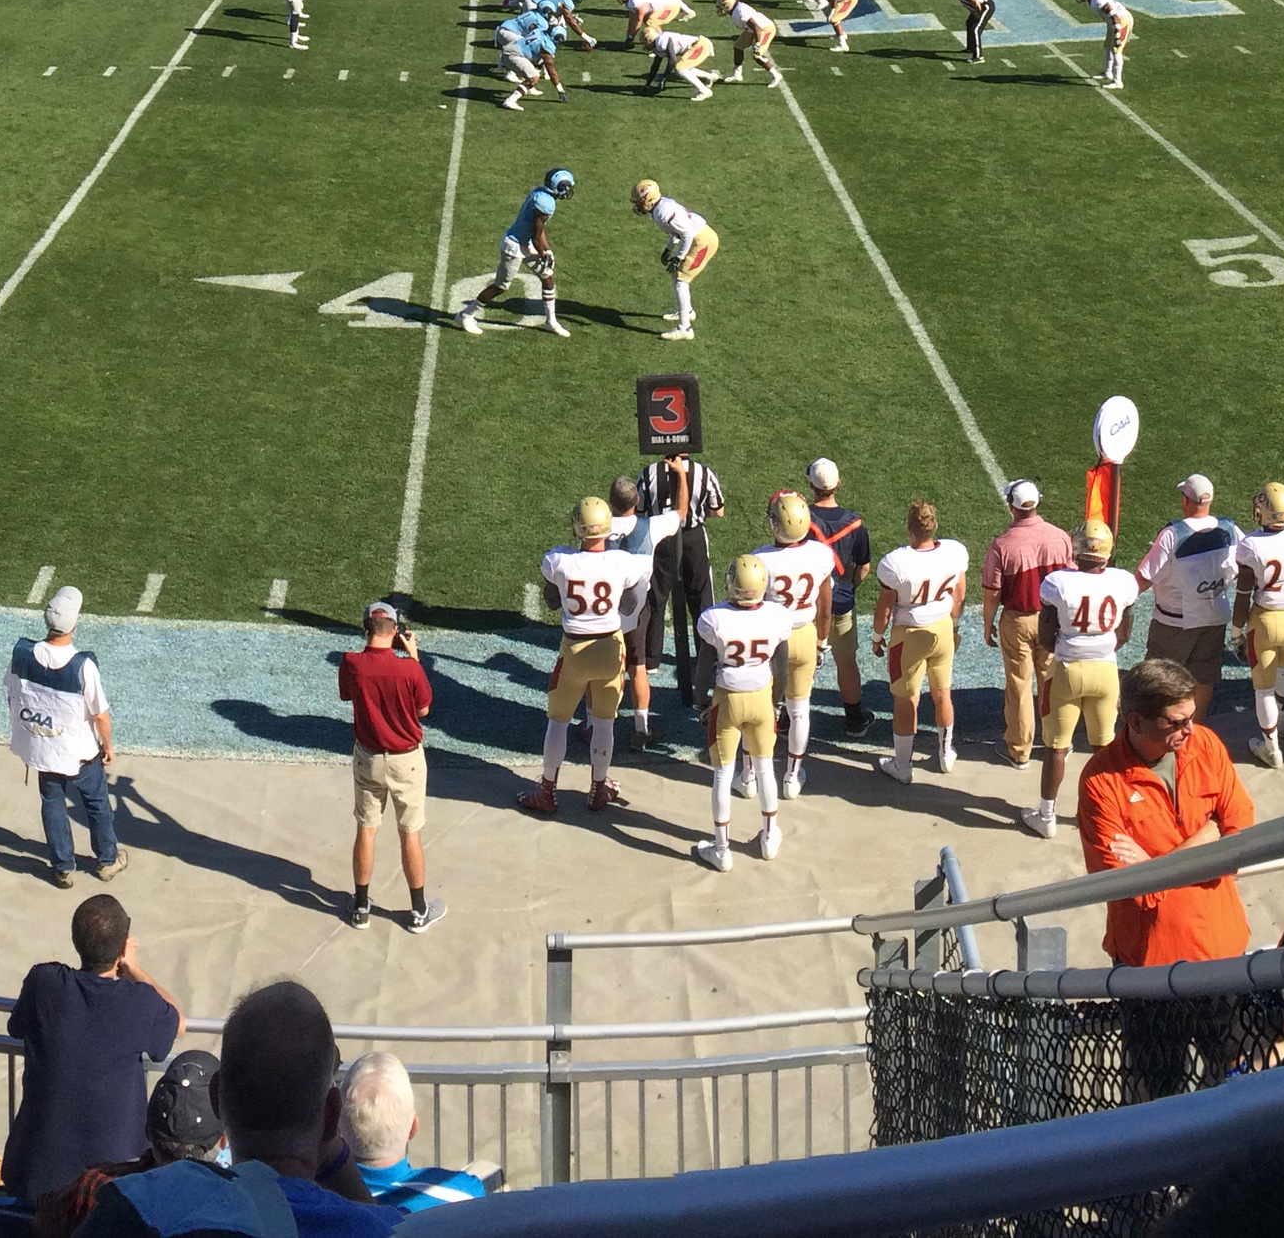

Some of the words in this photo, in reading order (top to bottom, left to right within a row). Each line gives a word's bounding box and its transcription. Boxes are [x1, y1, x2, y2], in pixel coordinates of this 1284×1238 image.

[318, 271, 547, 330] 40
[649, 386, 690, 434] 3
[1110, 415, 1131, 436] CAA
[566, 580, 613, 616] 58
[774, 573, 815, 611] 32
[910, 574, 956, 606] 46
[1197, 576, 1227, 594] CAA
[1071, 595, 1118, 634] 40
[725, 639, 770, 668] 35
[20, 708, 53, 729] CAA
